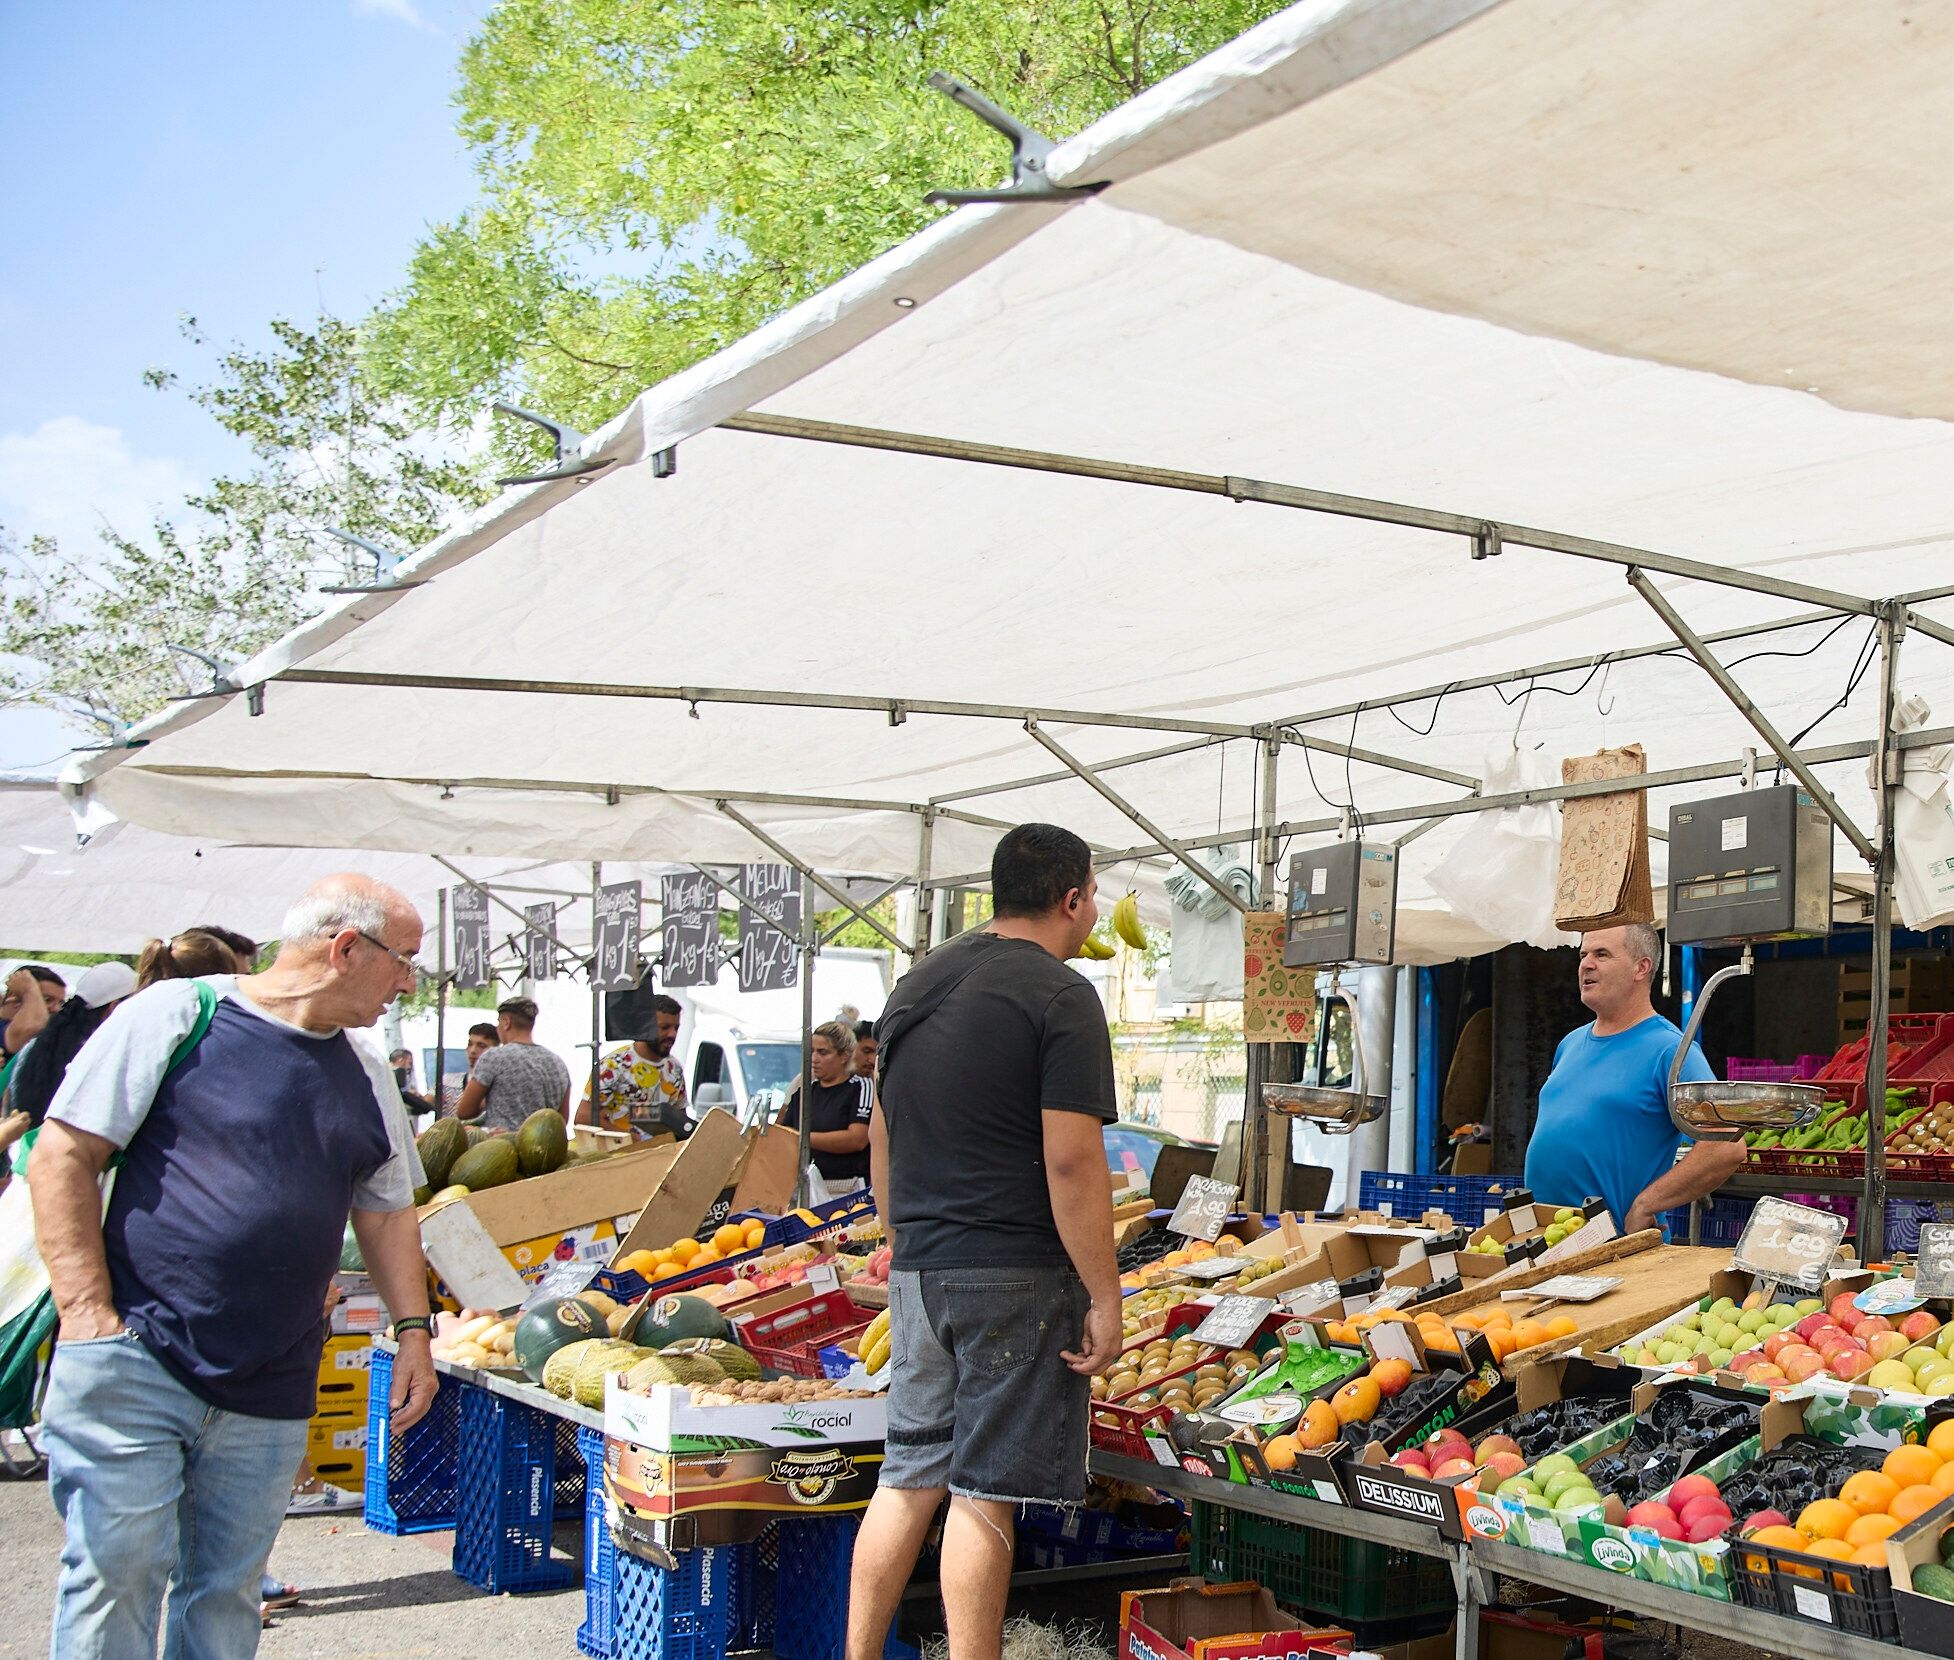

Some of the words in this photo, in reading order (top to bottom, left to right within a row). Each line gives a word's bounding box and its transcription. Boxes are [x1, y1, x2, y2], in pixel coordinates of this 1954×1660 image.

[663, 925, 680, 983] 2
[680, 941, 697, 975] kg
[1207, 1219, 1223, 1237] €
[812, 1412, 852, 1428] rocial
[780, 1464, 799, 1478] Oro
[805, 1461, 839, 1477] Conejo
[530, 1467, 542, 1516] Plasencia
[1360, 1480, 1440, 1516] DELISSIUM
[701, 1547, 715, 1607] Plasencia
